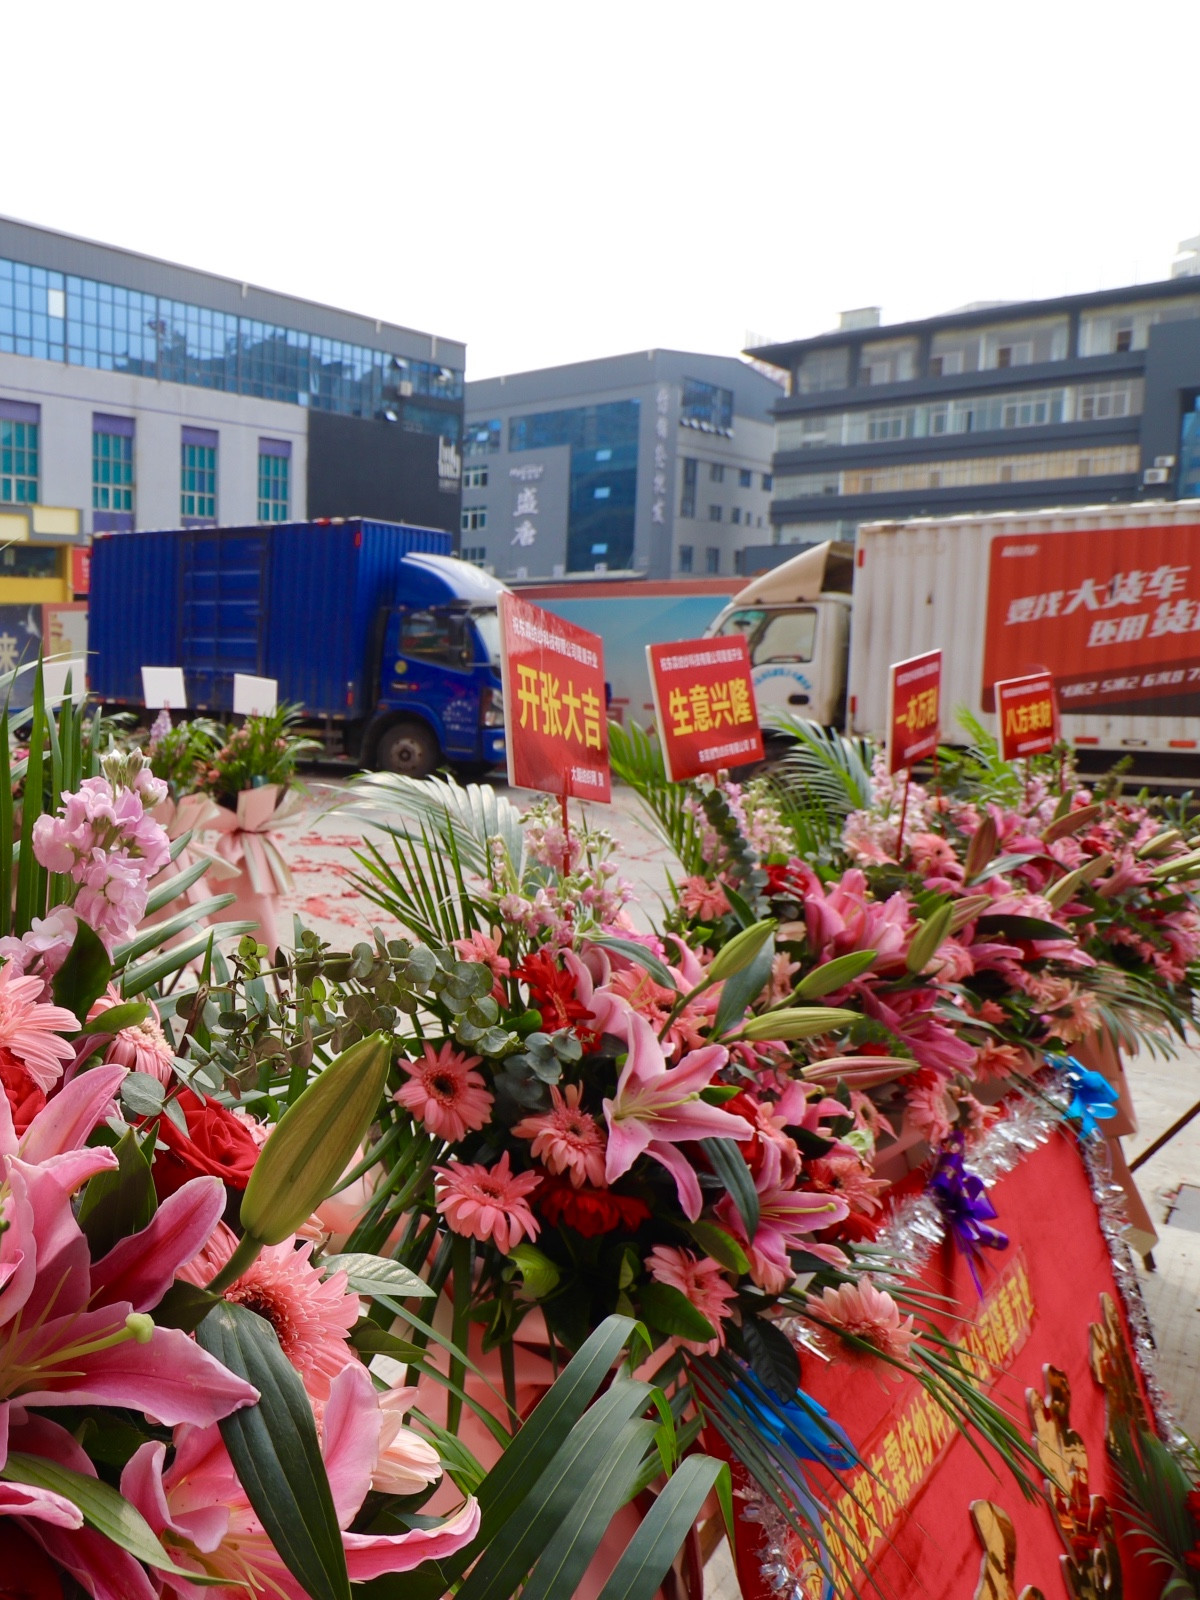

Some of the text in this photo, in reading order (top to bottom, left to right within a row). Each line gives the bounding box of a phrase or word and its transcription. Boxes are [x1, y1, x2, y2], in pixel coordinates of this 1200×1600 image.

[1005, 564, 1191, 626] 要找大货车
[517, 663, 601, 751] 开张大吉
[669, 678, 753, 736] 生意兴隆
[896, 688, 938, 733] 一本万利
[1006, 701, 1051, 736] 八方来财
